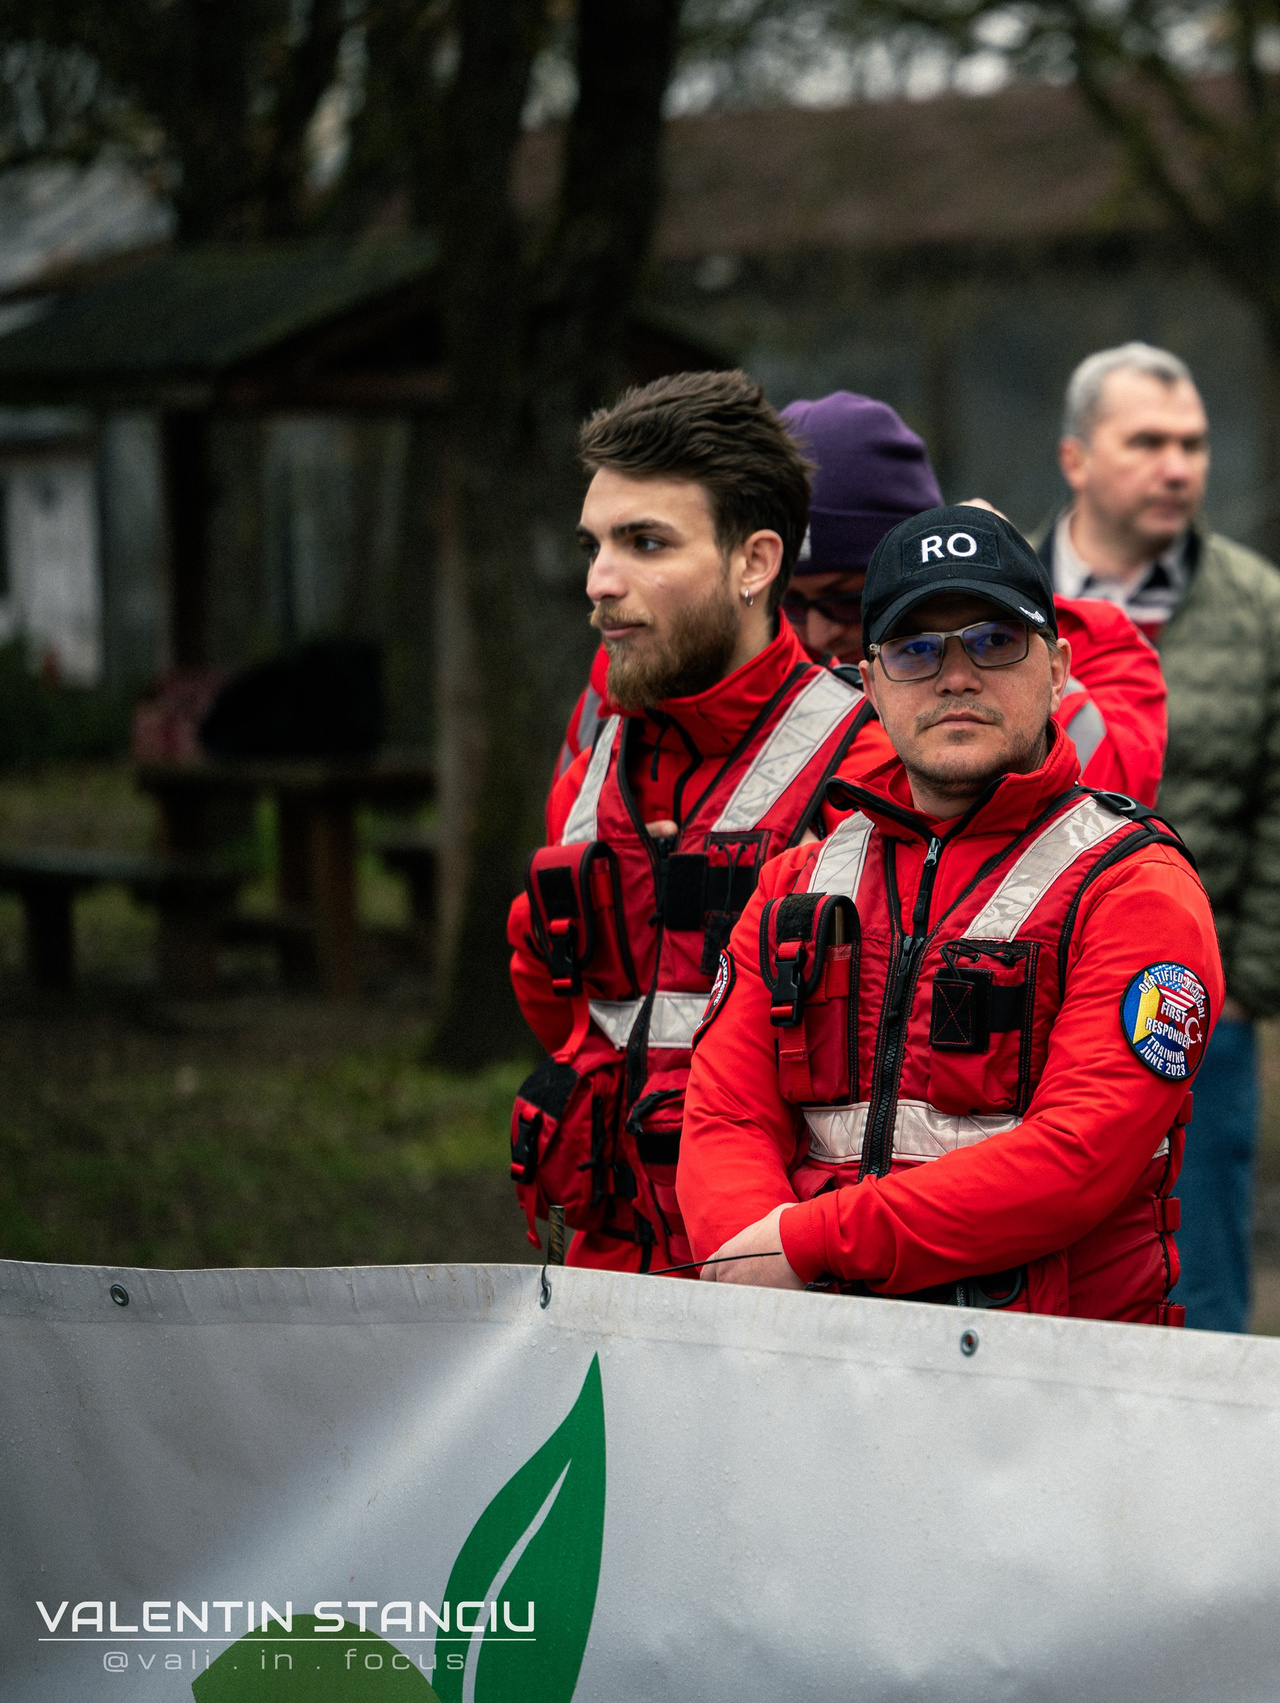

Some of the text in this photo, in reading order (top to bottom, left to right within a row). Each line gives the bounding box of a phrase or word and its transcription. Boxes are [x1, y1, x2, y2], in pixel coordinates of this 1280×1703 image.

[921, 532, 977, 563] RO
[1138, 970, 1184, 994] CERTIFIED
[1160, 1001, 1188, 1024] FIRST
[1145, 1017, 1190, 1050] RESPONDER
[1140, 1045, 1186, 1077] JUNE 2023
[1146, 1035, 1185, 1063] TRAINING
